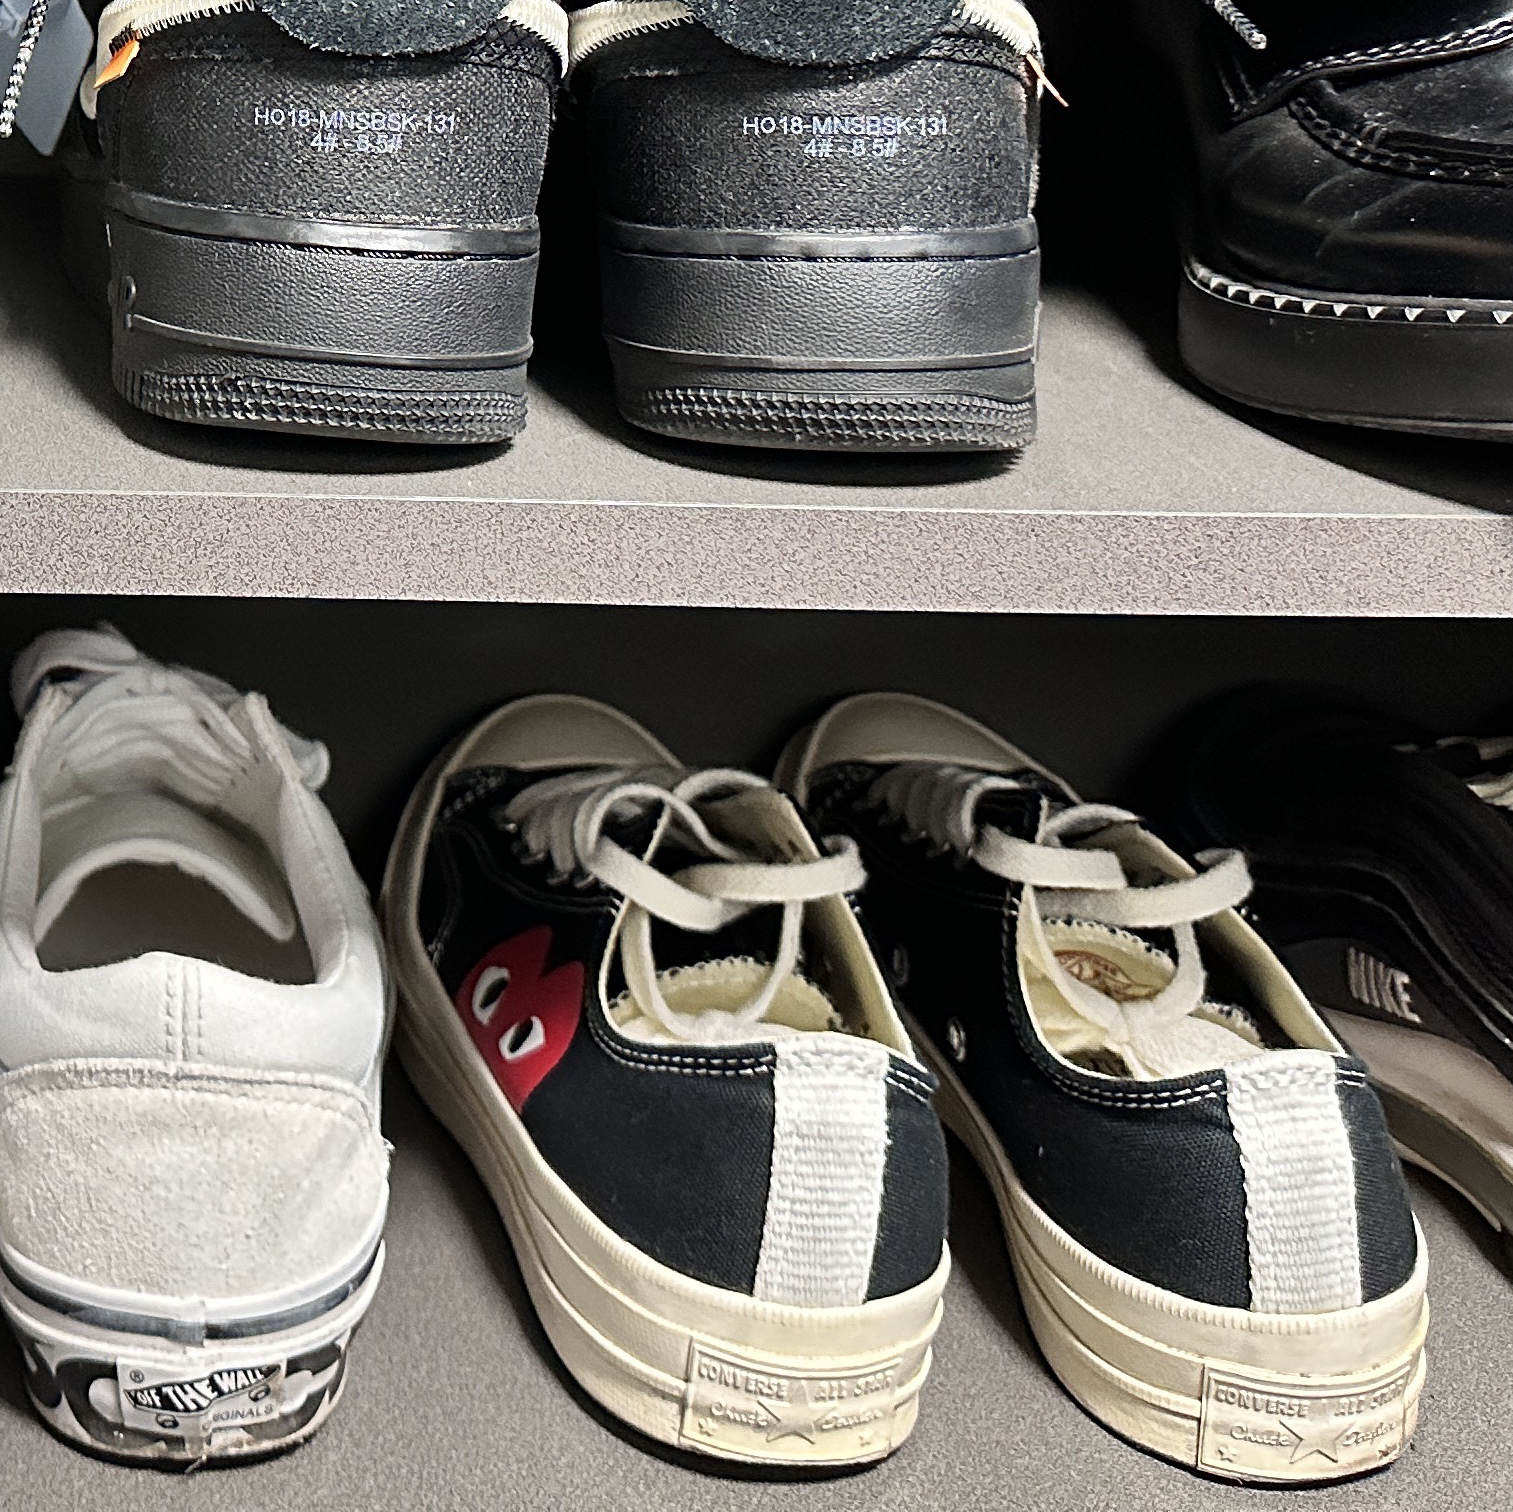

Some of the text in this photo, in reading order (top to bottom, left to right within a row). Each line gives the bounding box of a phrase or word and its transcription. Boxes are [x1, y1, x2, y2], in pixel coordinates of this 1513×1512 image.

[804, 138, 834, 158] 4#
[1348, 946, 1422, 1024] NIKE
[697, 1357, 789, 1399] CONVERSE
[162, 1379, 219, 1411] THE
[1215, 1385, 1311, 1418] CONVERSE
